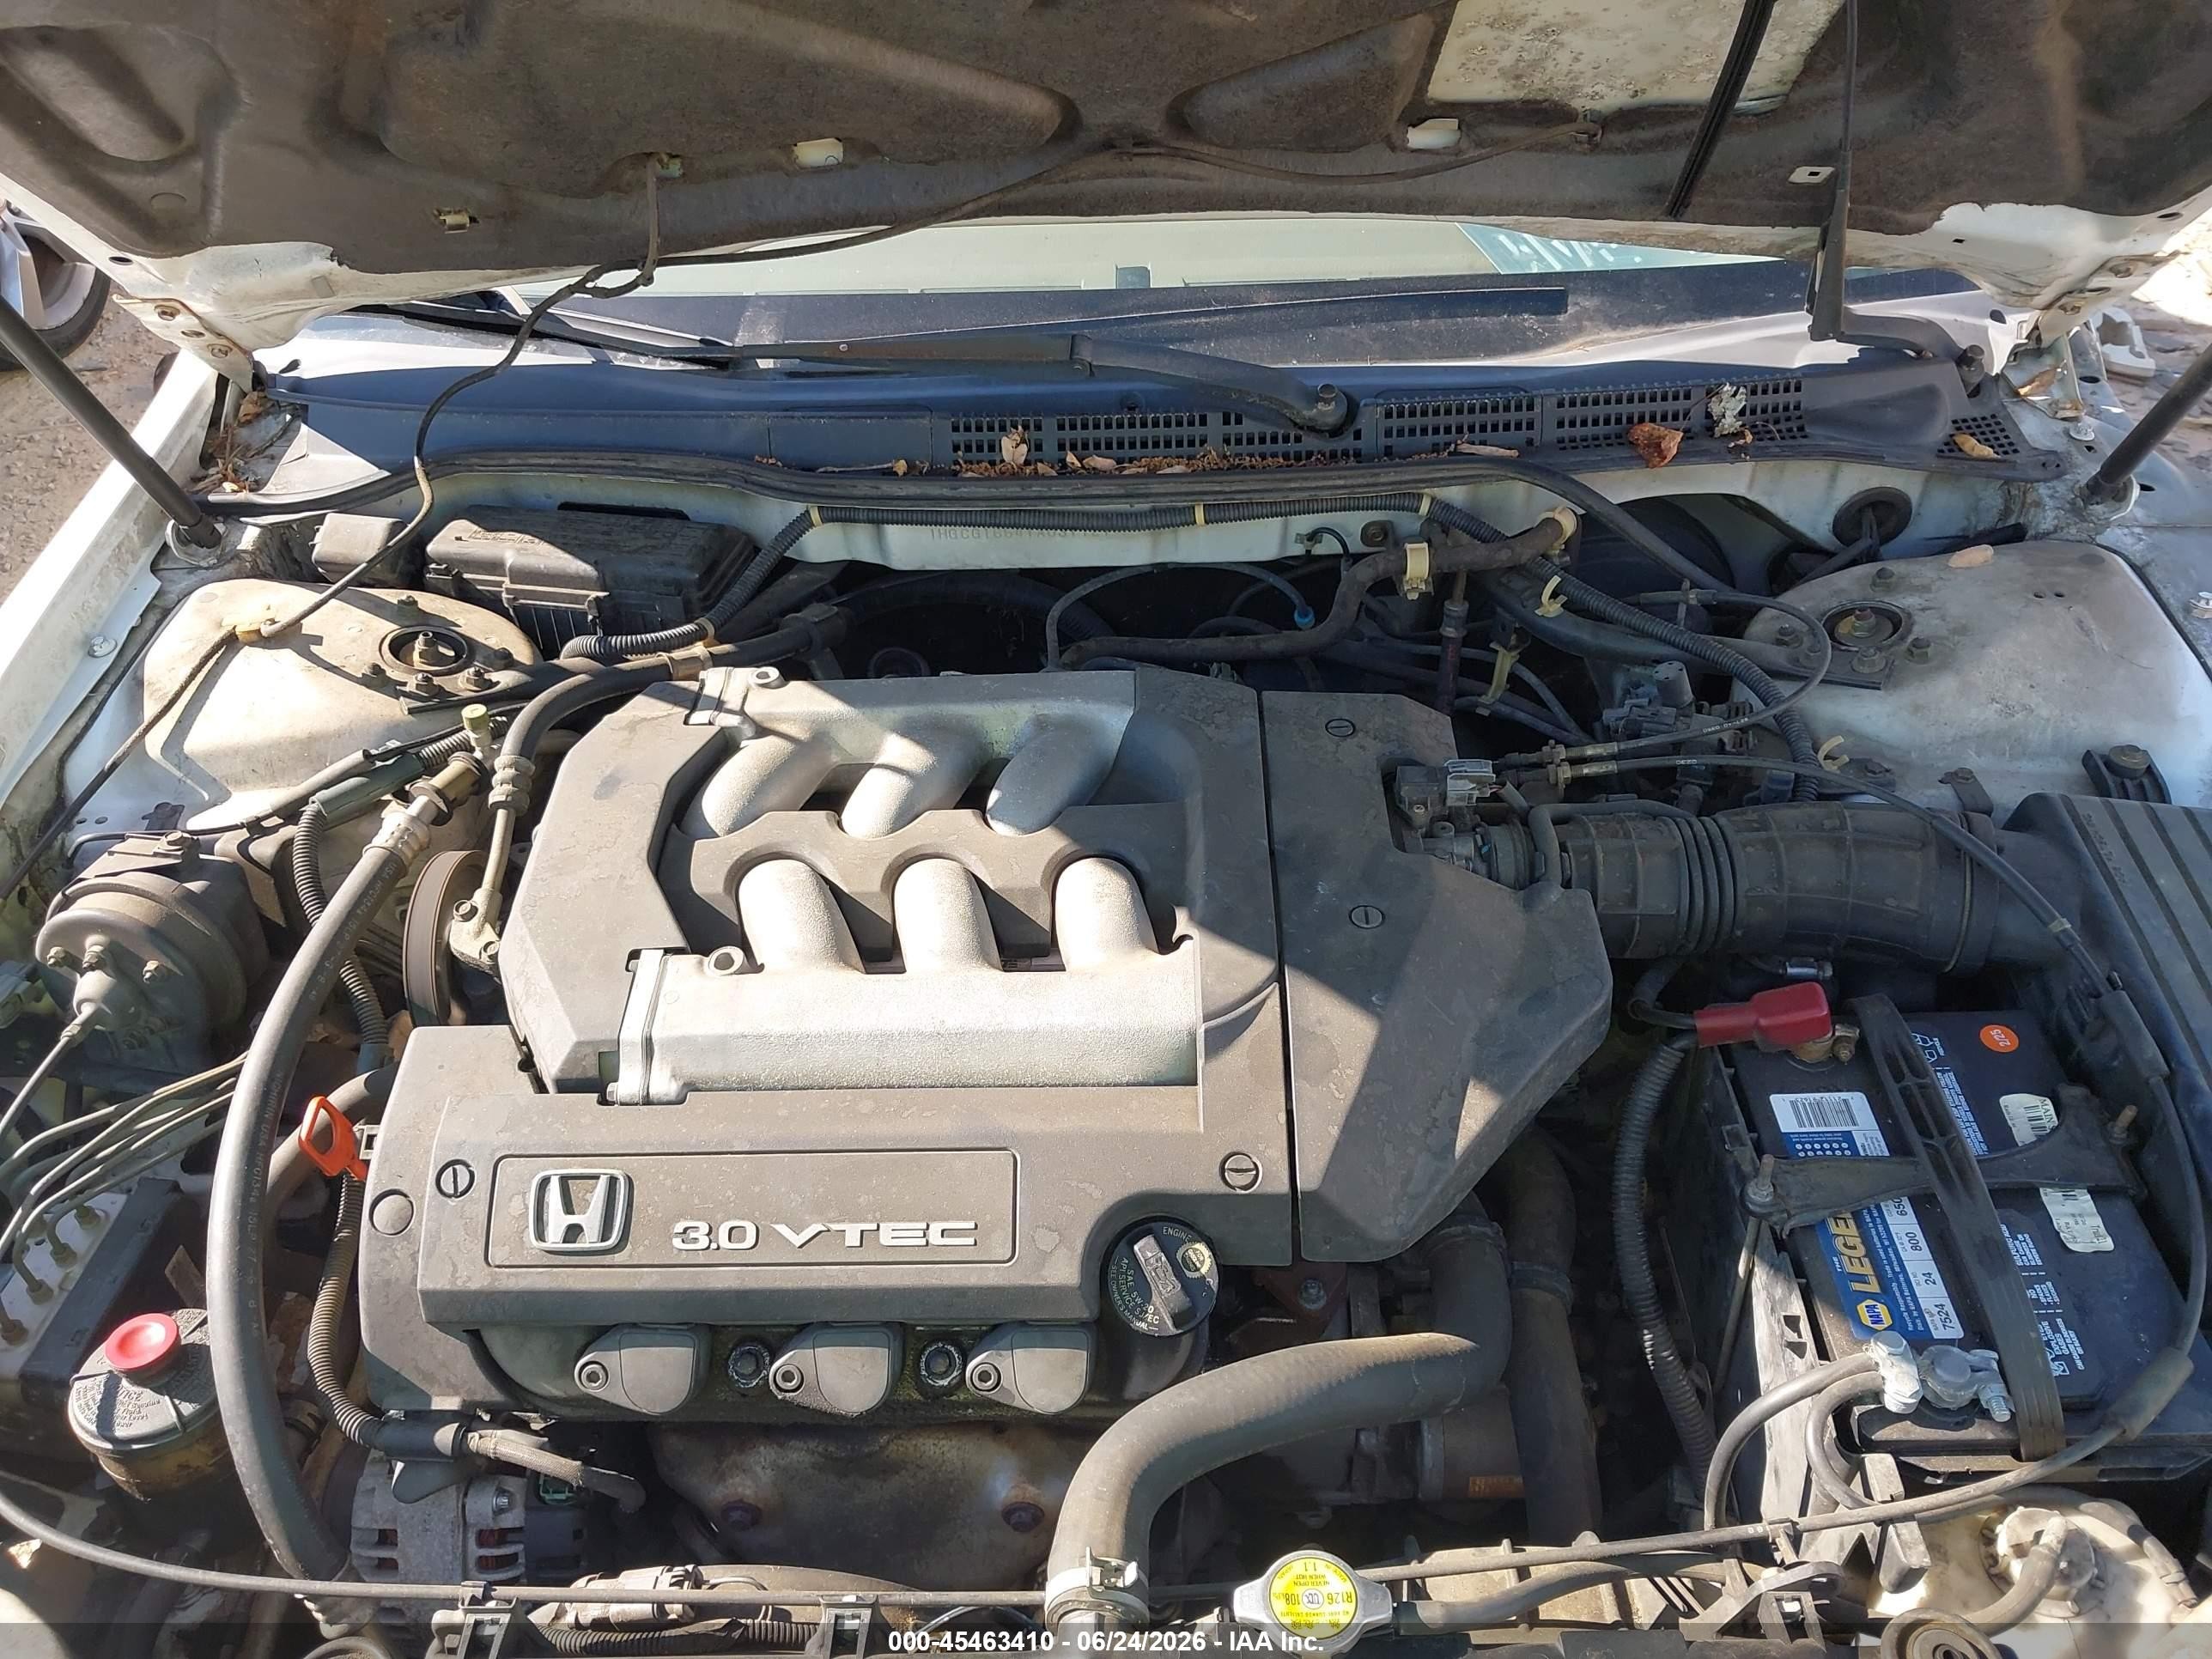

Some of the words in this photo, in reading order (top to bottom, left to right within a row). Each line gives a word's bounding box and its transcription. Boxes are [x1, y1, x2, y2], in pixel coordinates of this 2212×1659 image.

[1990, 1029, 2012, 1047] 2/25
[672, 1220, 758, 1251] 3.0
[773, 1221, 978, 1249] VTEC
[1905, 1231, 1923, 1253] 800
[1120, 1256, 1129, 1273] API
[1832, 1256, 1843, 1272] THE
[1127, 1269, 1135, 1289] SAE
[1922, 1271, 1937, 1286] 24
[1118, 1273, 1138, 1309] SERVICE
[1864, 1303, 1886, 1326] NAPA
[1933, 1303, 1955, 1331] 7524
[1326, 1591, 1352, 1604] R126
